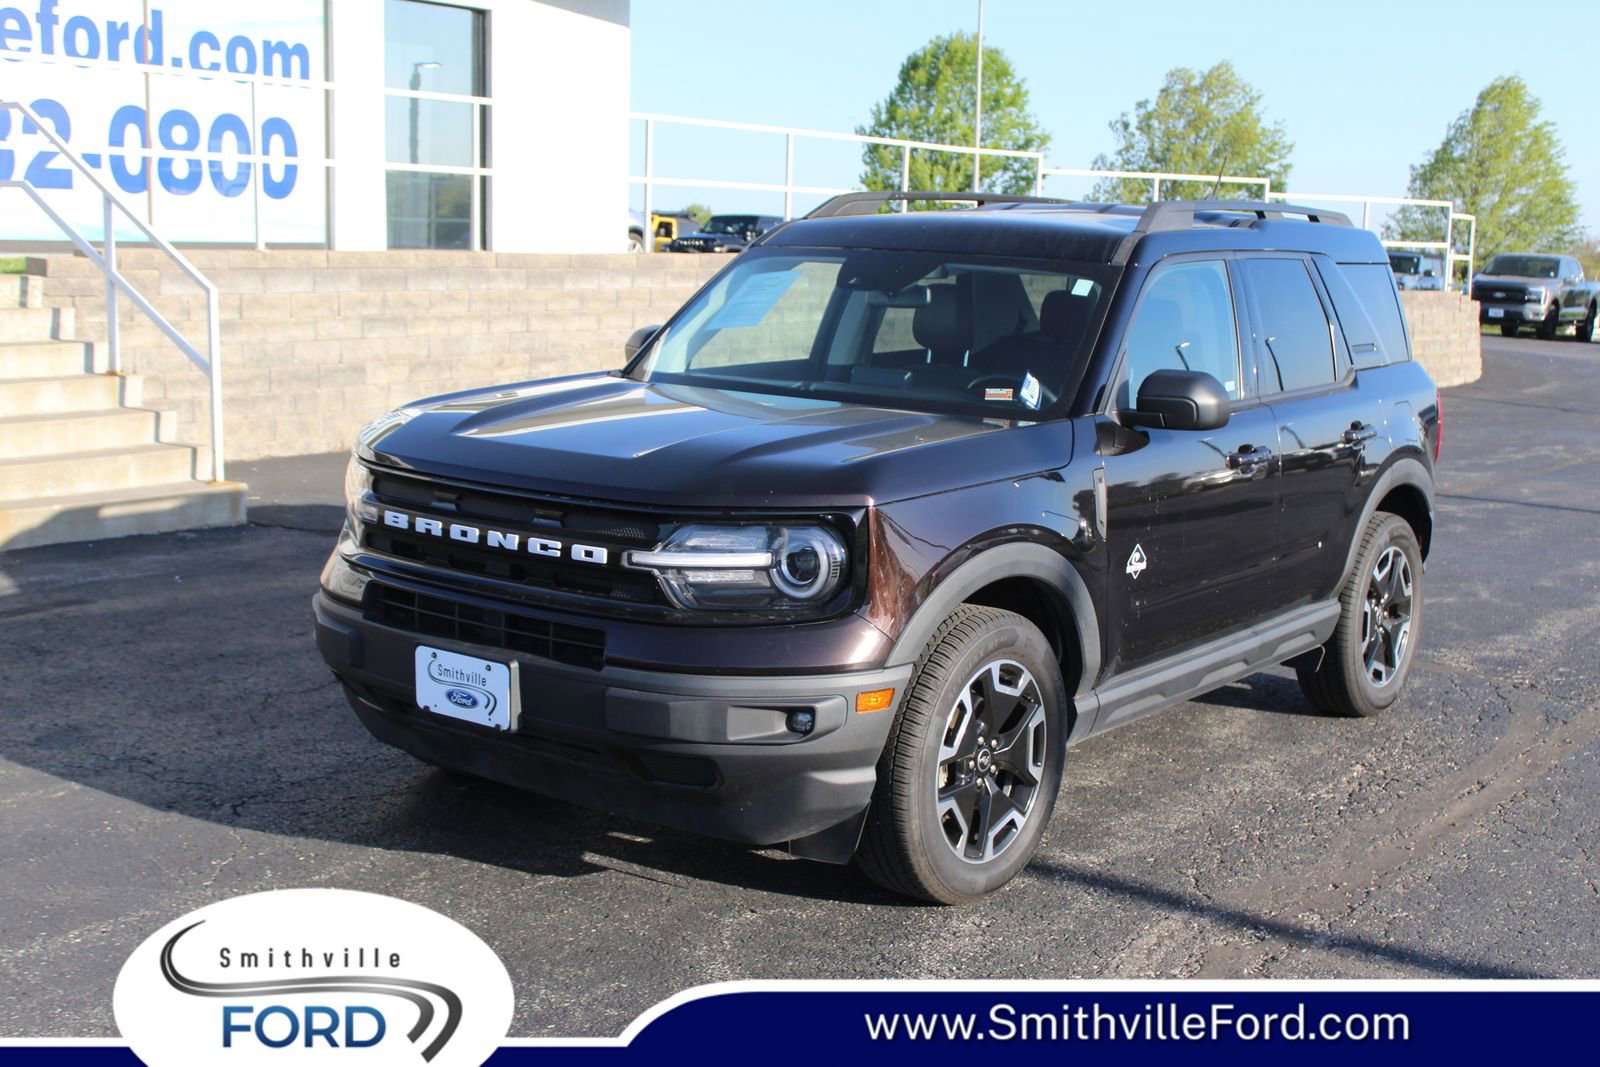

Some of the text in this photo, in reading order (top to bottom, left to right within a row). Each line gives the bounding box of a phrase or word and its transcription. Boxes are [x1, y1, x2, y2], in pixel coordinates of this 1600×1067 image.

[384, 509, 608, 565] BRONCO
[437, 663, 487, 687] Smithville
[450, 690, 474, 707] Ford
